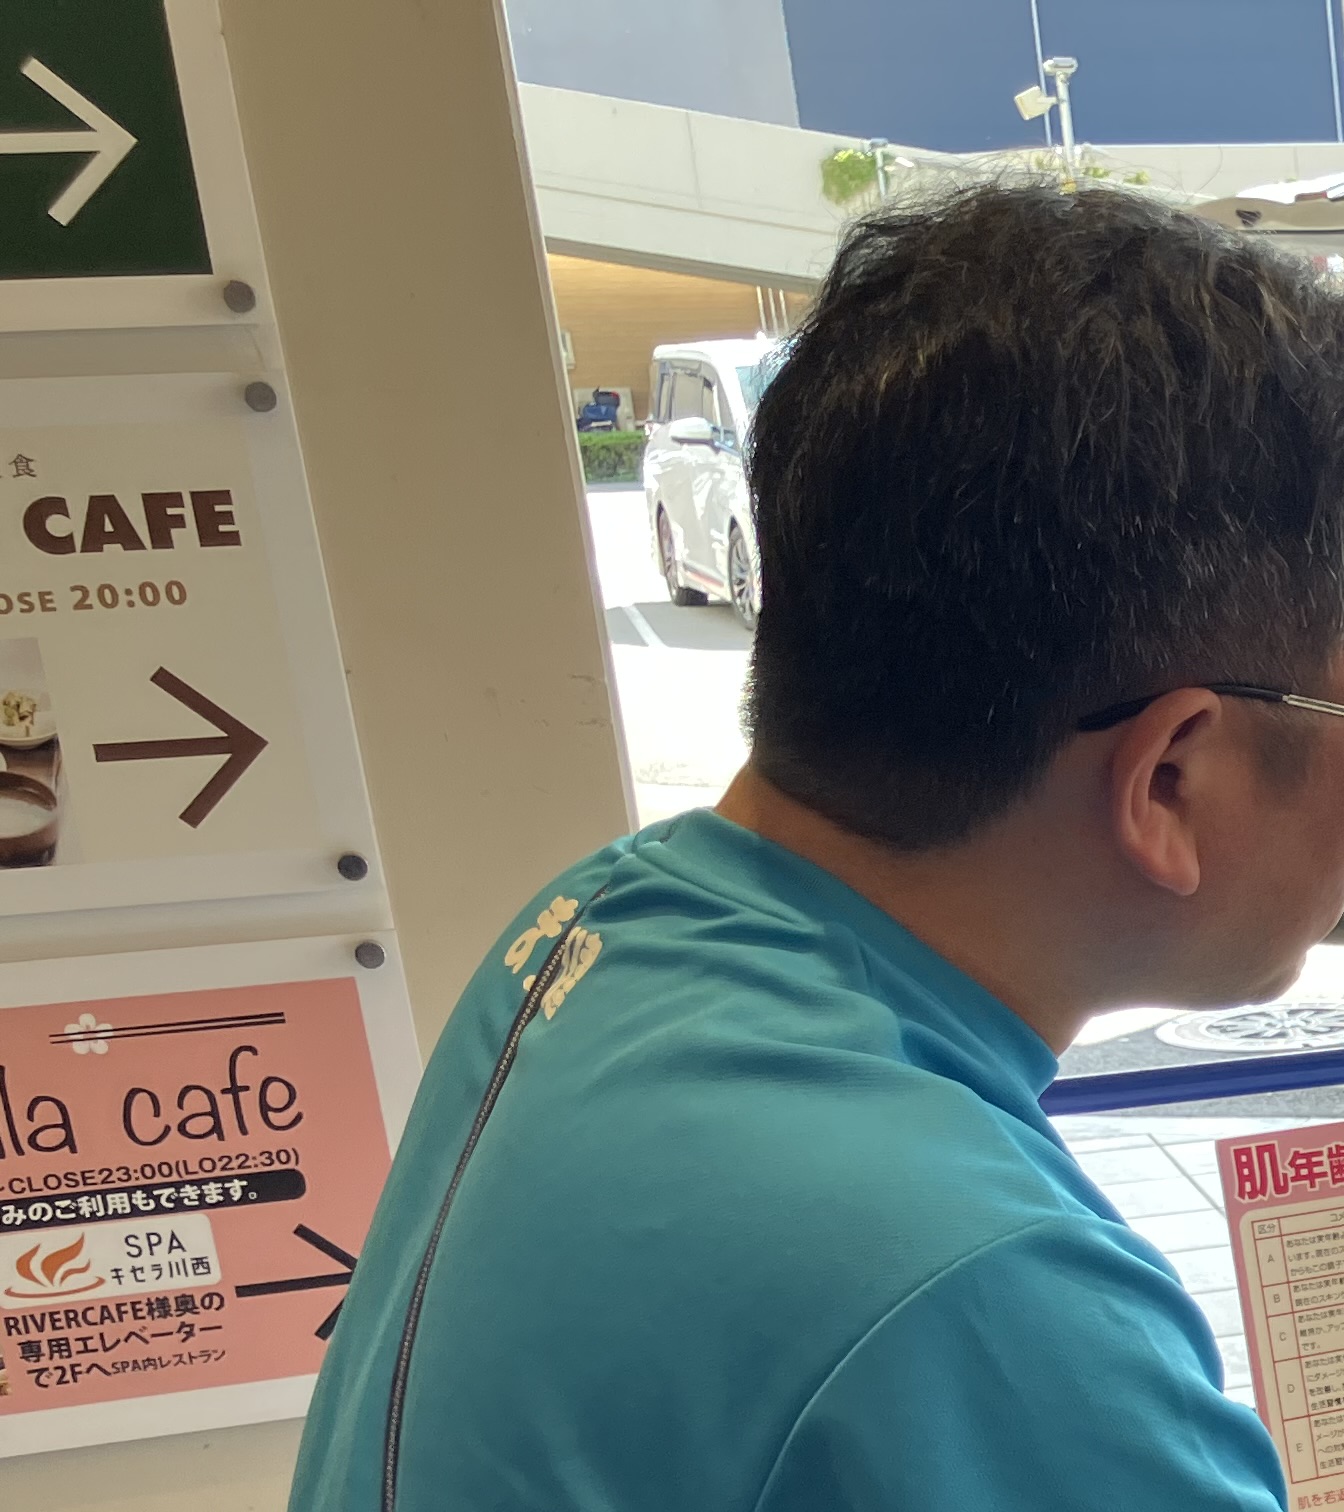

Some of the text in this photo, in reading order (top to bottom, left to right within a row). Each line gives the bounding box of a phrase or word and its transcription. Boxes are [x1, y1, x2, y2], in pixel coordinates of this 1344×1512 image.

[0, 454, 37, 478] 食
[23, 489, 242, 556] CAFE
[69, 579, 188, 612] 20:00
[0, 1045, 304, 1160] la cafe
[0, 1148, 301, 1196] CLOSE23:00(LO22:30)
[1, 1178, 259, 1226] みのご利用もできます。
[1256, 1222, 1276, 1235] 区分
[124, 1230, 187, 1258] SPA
[1266, 1253, 1275, 1263] A
[110, 1255, 213, 1287] キセラ川西
[1272, 1293, 1281, 1303] B
[4, 1290, 226, 1337] RIVERCAFE様奥の
[17, 1321, 224, 1362] 専用エレベーター
[1278, 1331, 1287, 1341] C
[1286, 1382, 1296, 1393] D
[1295, 1442, 1304, 1453] E
